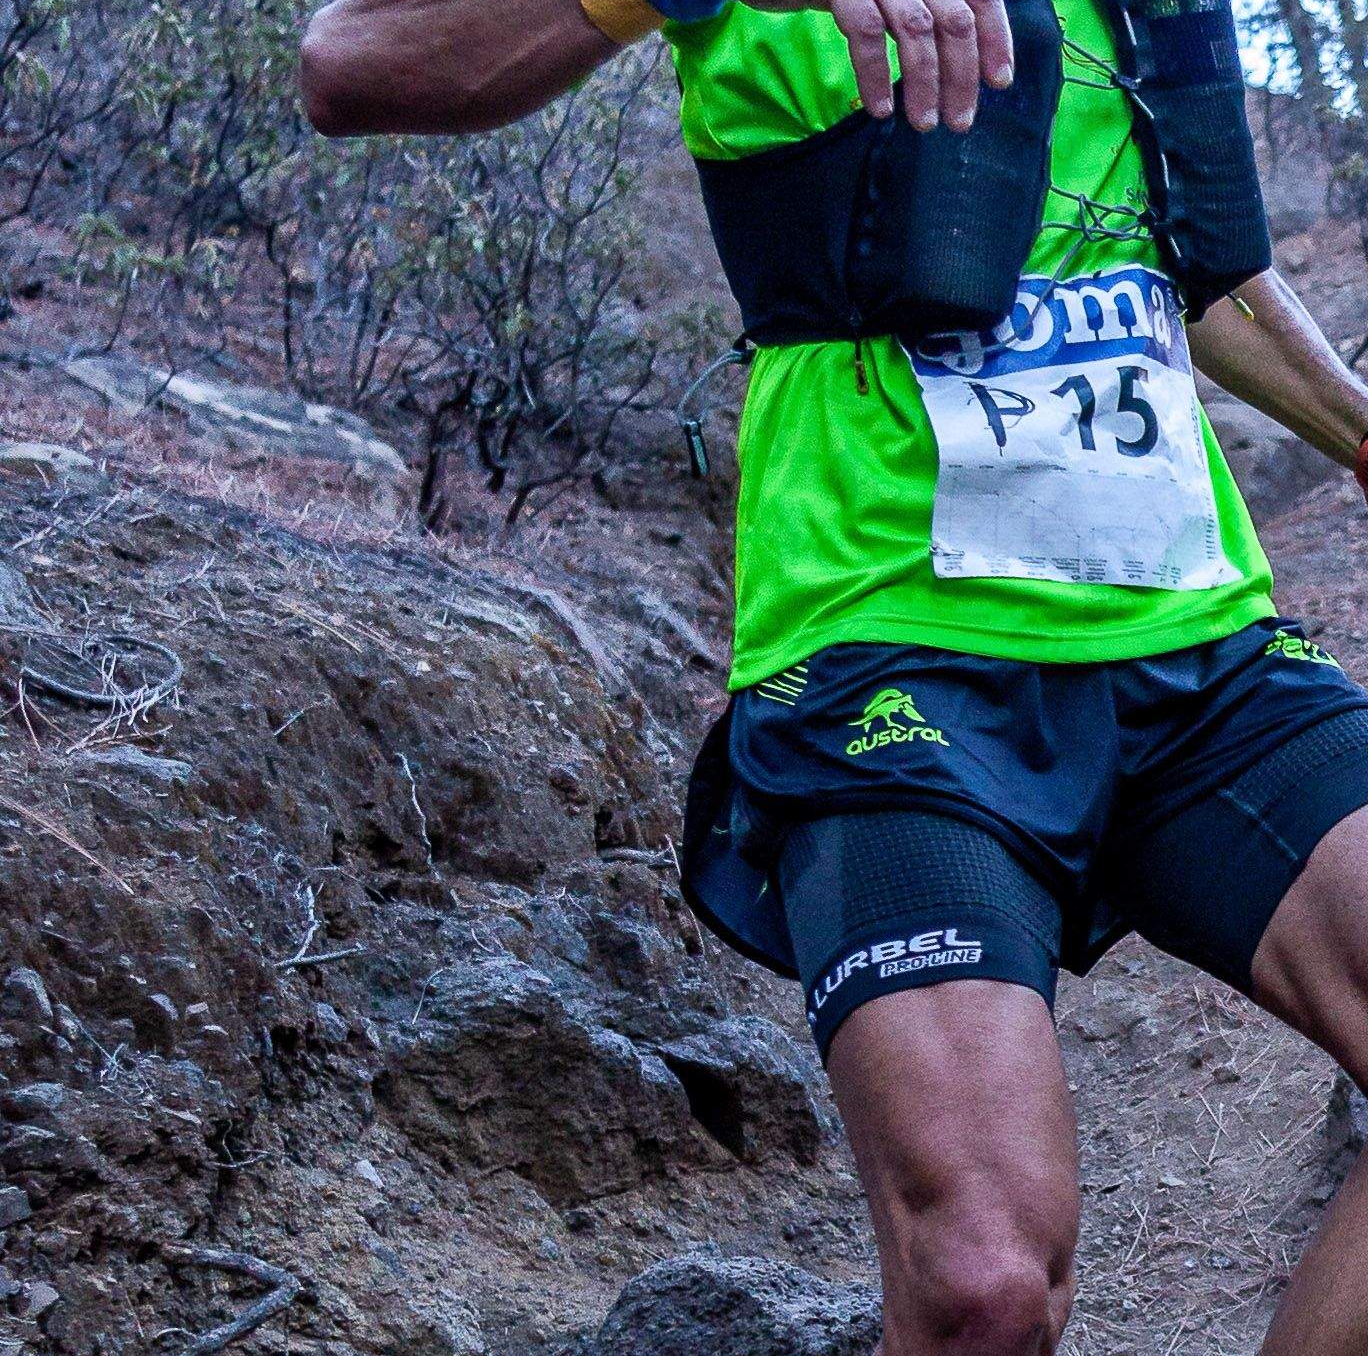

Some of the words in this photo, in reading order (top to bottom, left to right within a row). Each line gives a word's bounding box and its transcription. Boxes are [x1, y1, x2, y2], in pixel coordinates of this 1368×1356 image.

[1050, 365, 1159, 458] 15
[846, 726, 950, 756] austral
[814, 928, 981, 1009] LURBEL
